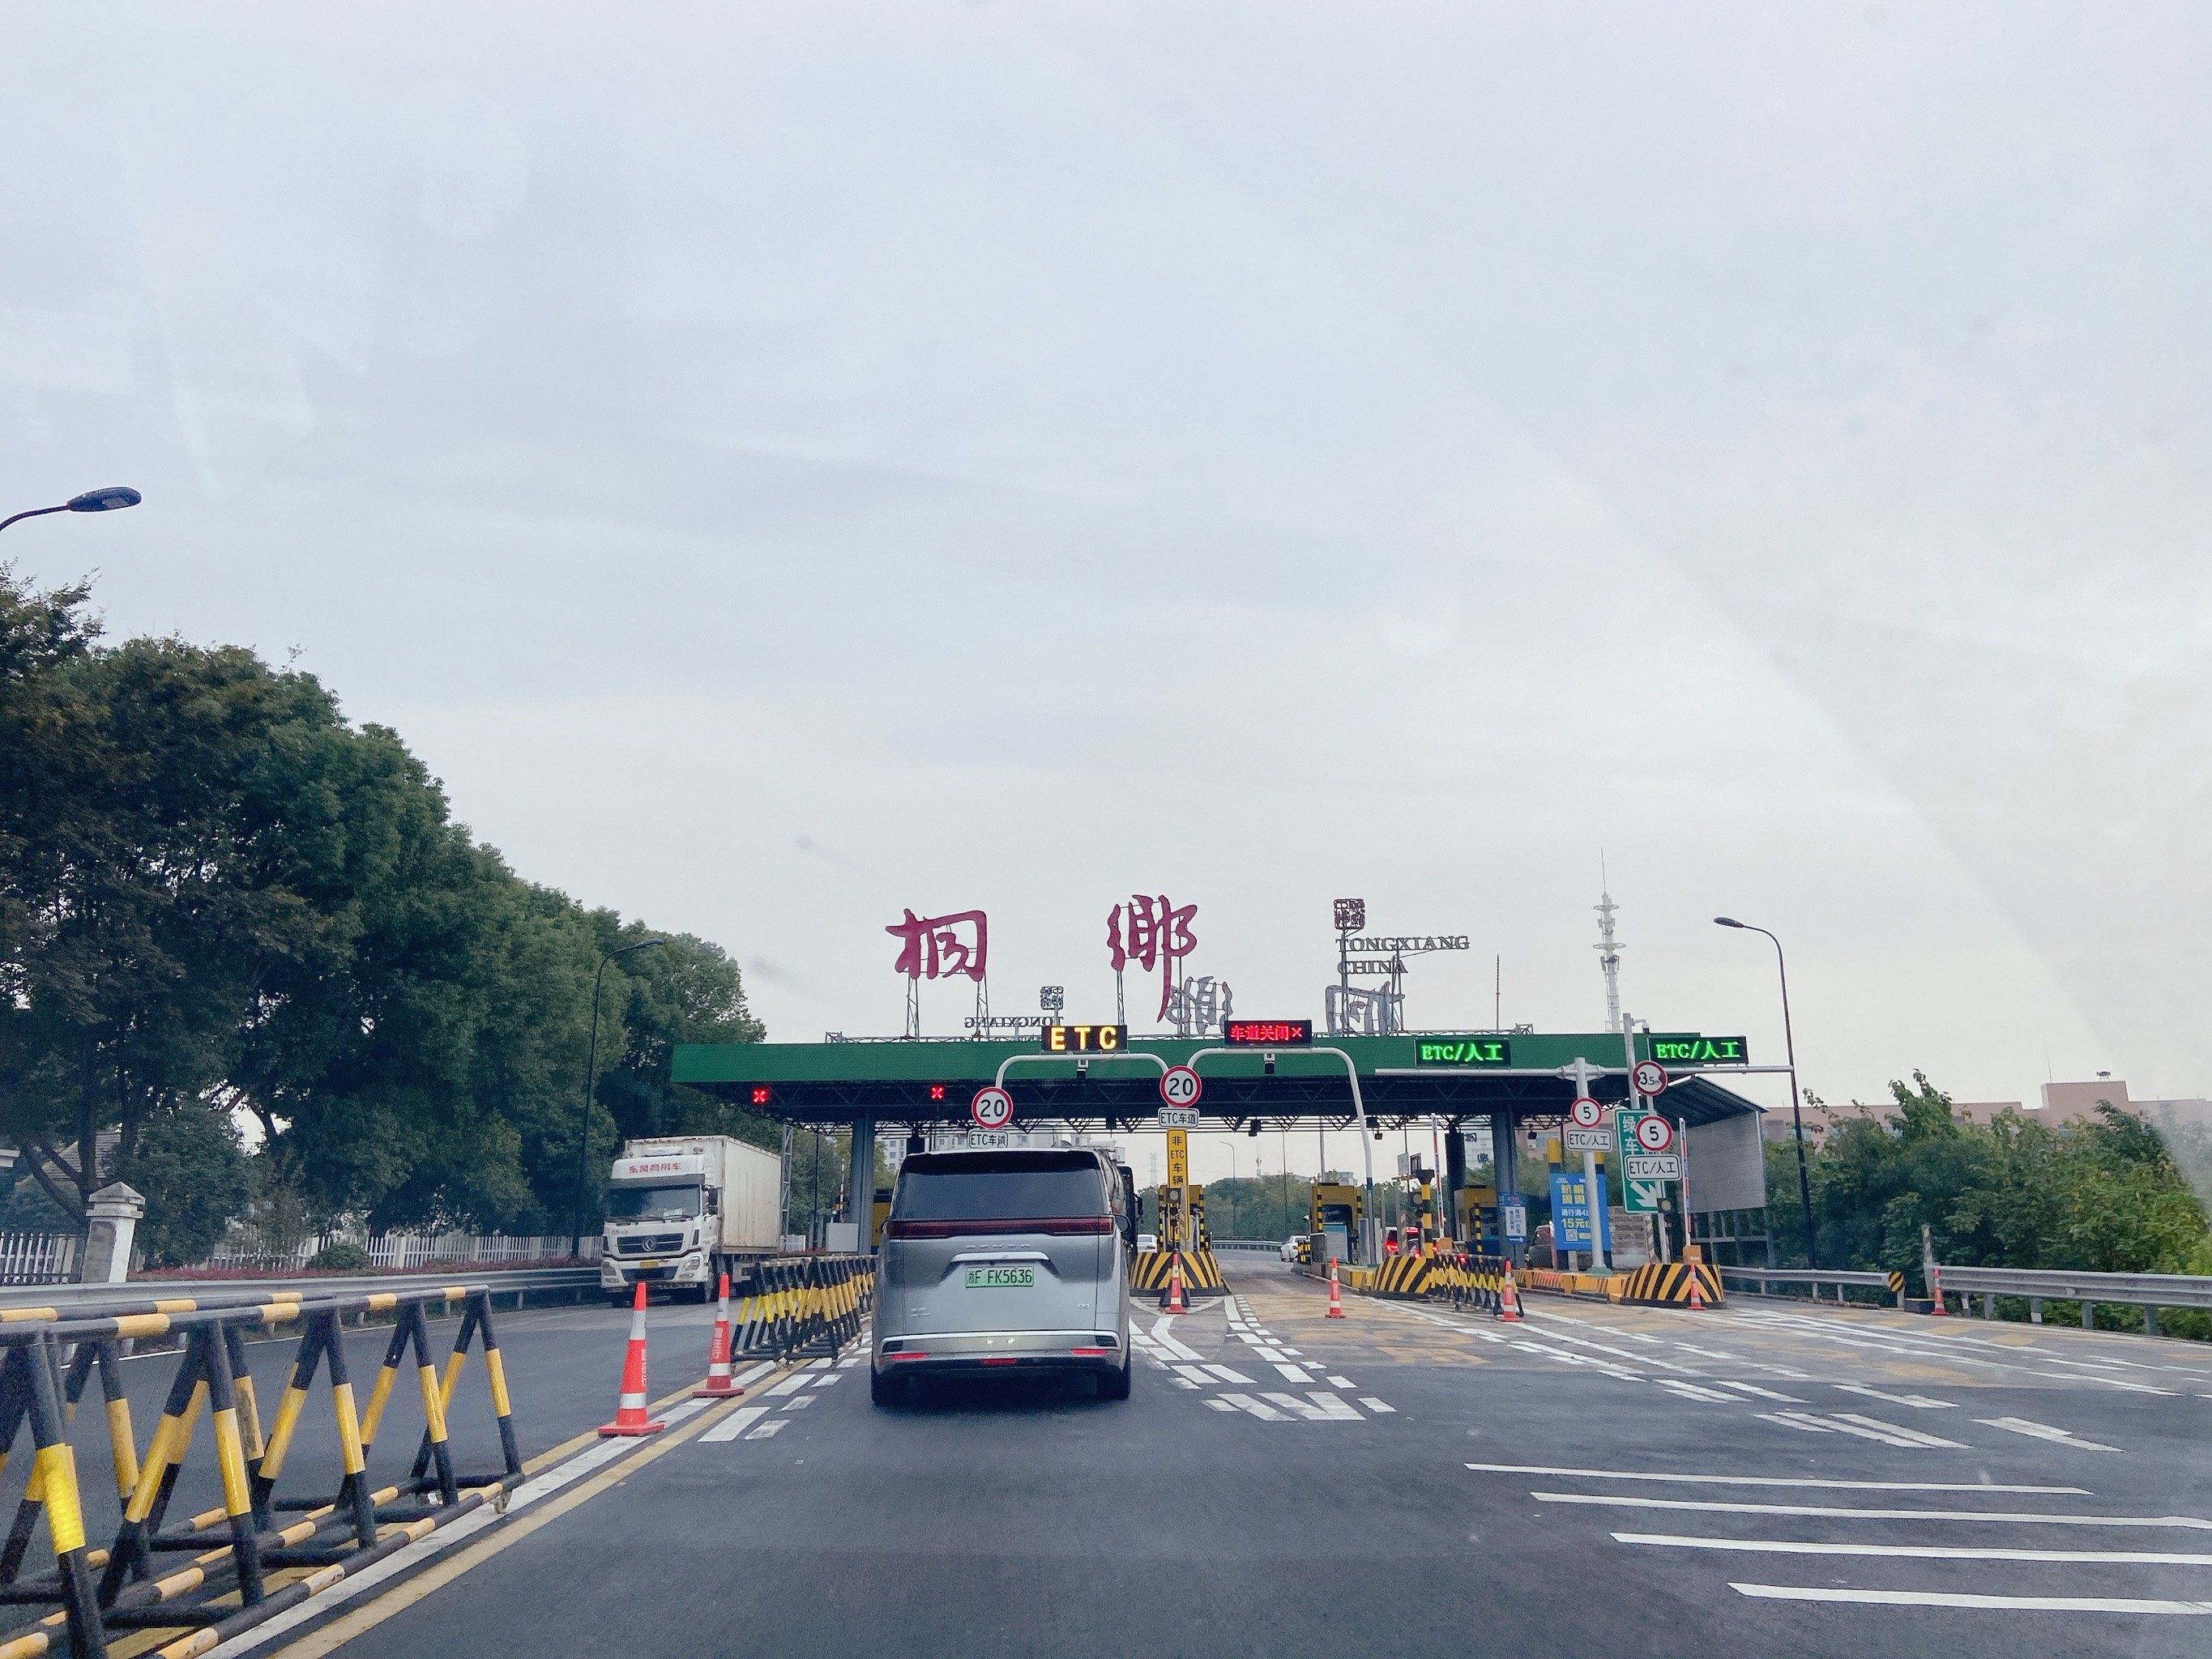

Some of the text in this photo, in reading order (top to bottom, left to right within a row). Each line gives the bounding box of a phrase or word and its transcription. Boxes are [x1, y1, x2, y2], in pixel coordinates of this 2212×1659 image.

[1335, 936, 1470, 952] TONGXIANG
[1337, 959, 1408, 974] CHINA
[1051, 1026, 1117, 1051] ETC
[1231, 1025, 1289, 1041] 车道关闭
[1422, 1043, 1503, 1062] ETC/人工
[1656, 1041, 1741, 1060] ETC/人工
[1168, 1077, 1194, 1096] 20
[980, 1098, 1005, 1117] 20
[1583, 1107, 1591, 1120] 5
[1160, 1112, 1196, 1125] ETC车道
[1569, 1134, 1608, 1146] ETC/人工
[1649, 1126, 1659, 1141] 5
[1629, 1162, 1676, 1175] ETC/人工
[987, 1269, 1032, 1283] FK5636
